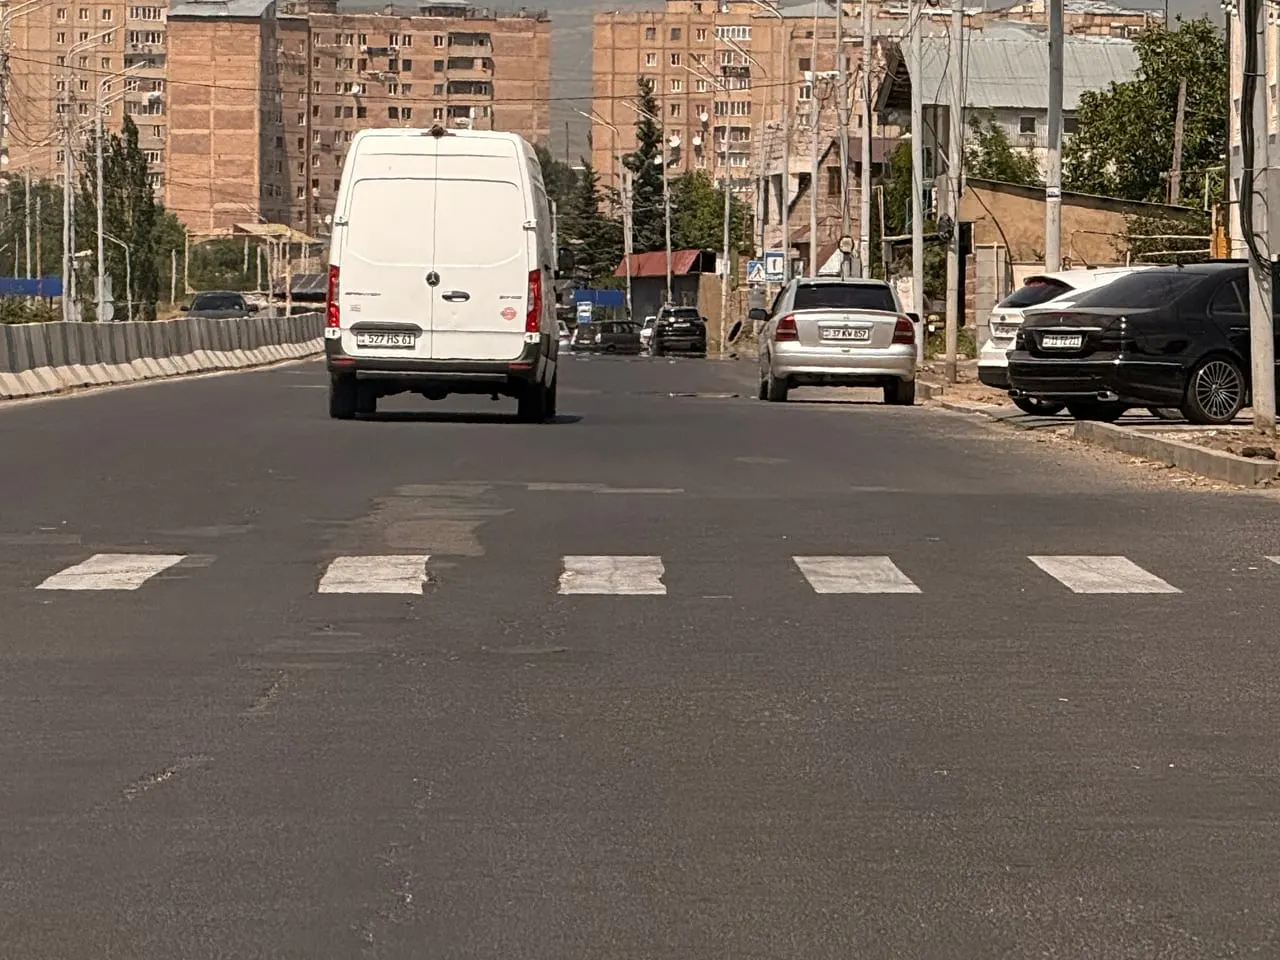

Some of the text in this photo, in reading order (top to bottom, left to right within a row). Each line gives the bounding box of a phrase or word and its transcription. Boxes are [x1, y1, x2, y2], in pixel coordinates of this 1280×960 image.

[368, 334, 412, 344] 527 HS 61
